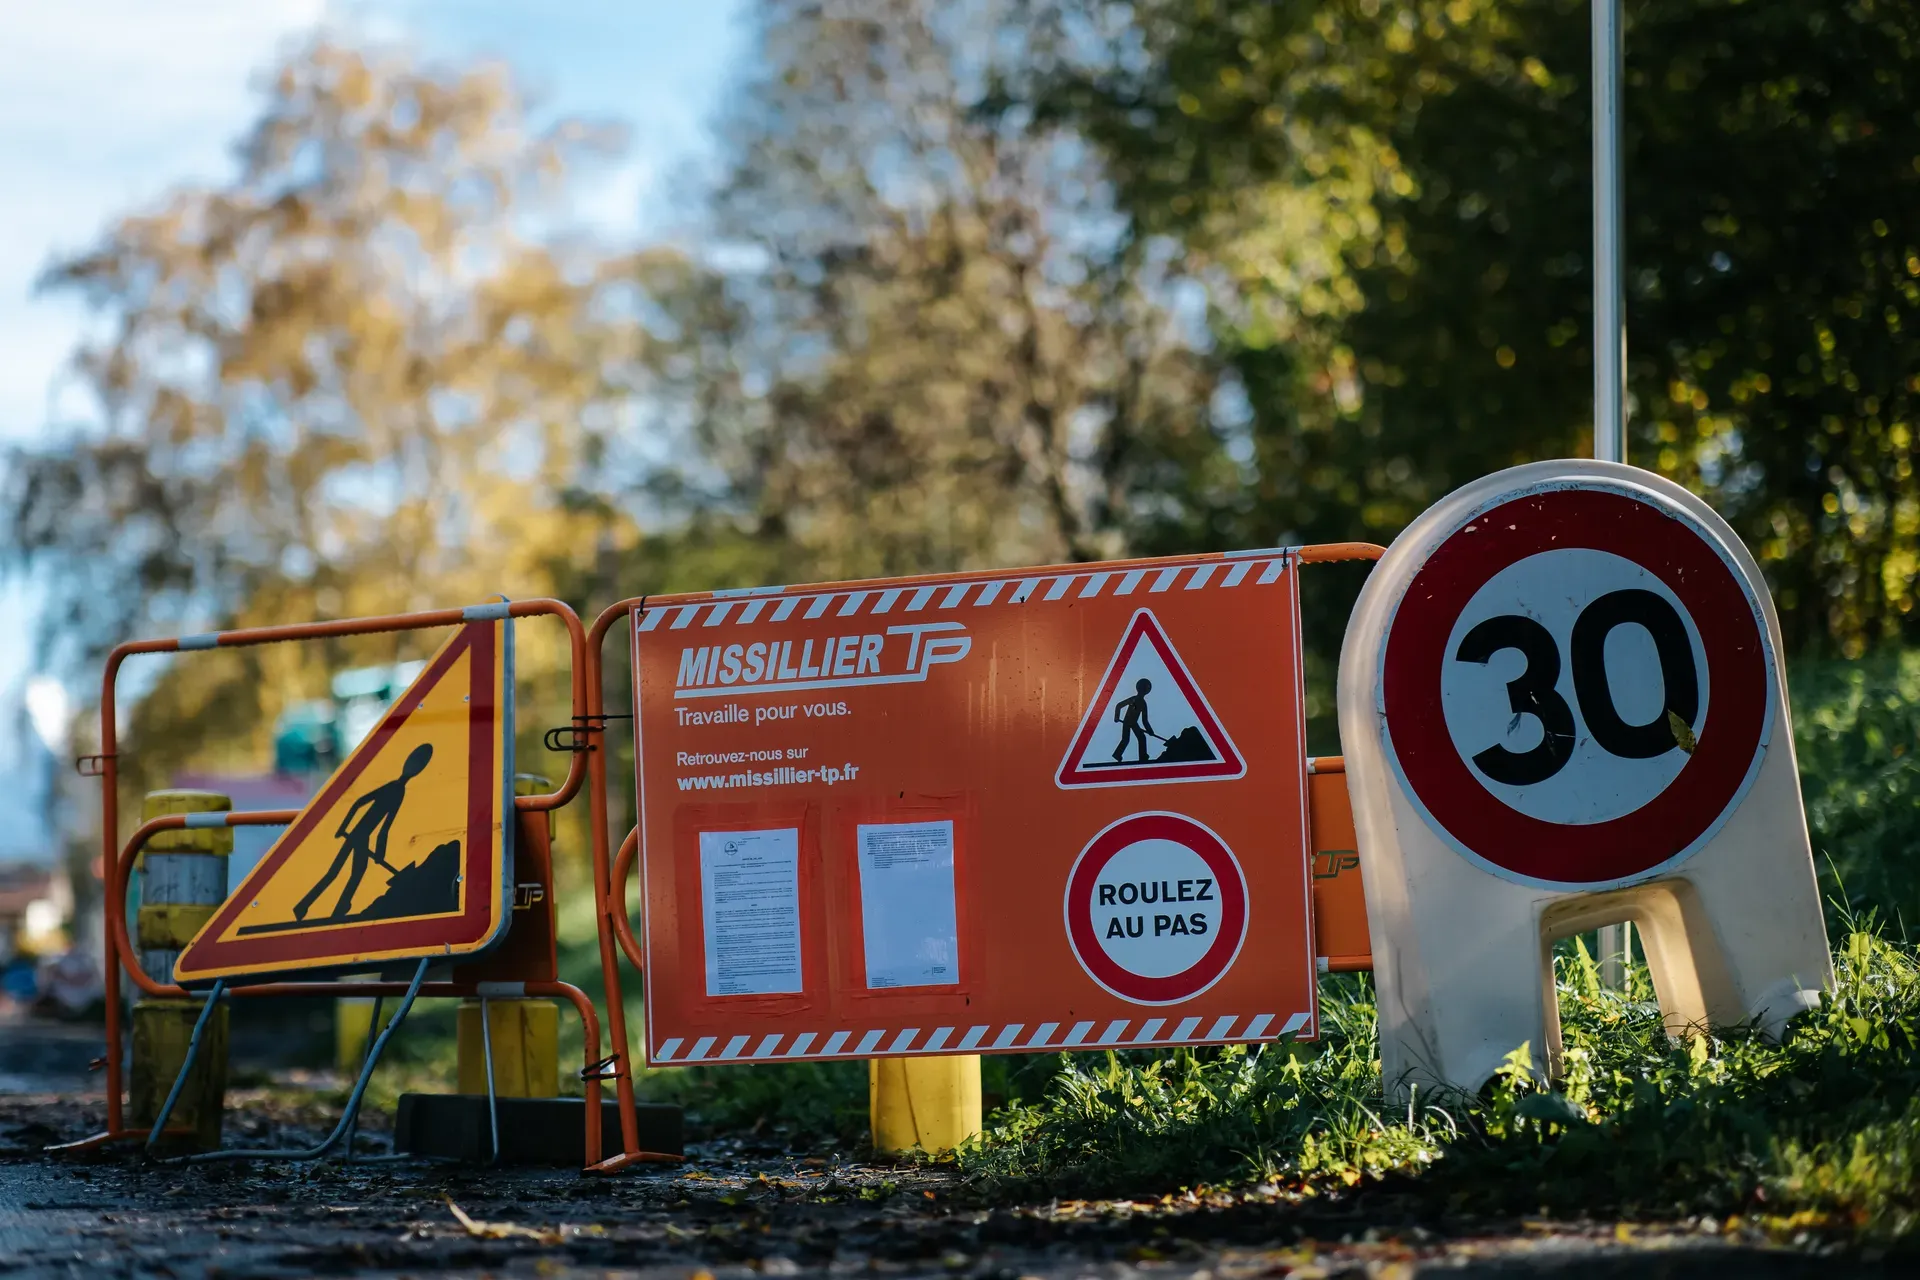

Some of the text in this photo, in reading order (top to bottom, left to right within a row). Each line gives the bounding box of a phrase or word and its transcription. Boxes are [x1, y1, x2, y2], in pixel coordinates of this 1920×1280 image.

[676, 634, 884, 687] MISSILLIER
[1455, 588, 1699, 786] 30
[674, 701, 852, 726] Travaille pour vous.
[677, 746, 809, 766] Retrouvez-nous sur
[677, 763, 859, 791] www.missillier-tp.fr
[1099, 878, 1214, 906] ROULEZ
[1106, 912, 1208, 939] AU PAS
